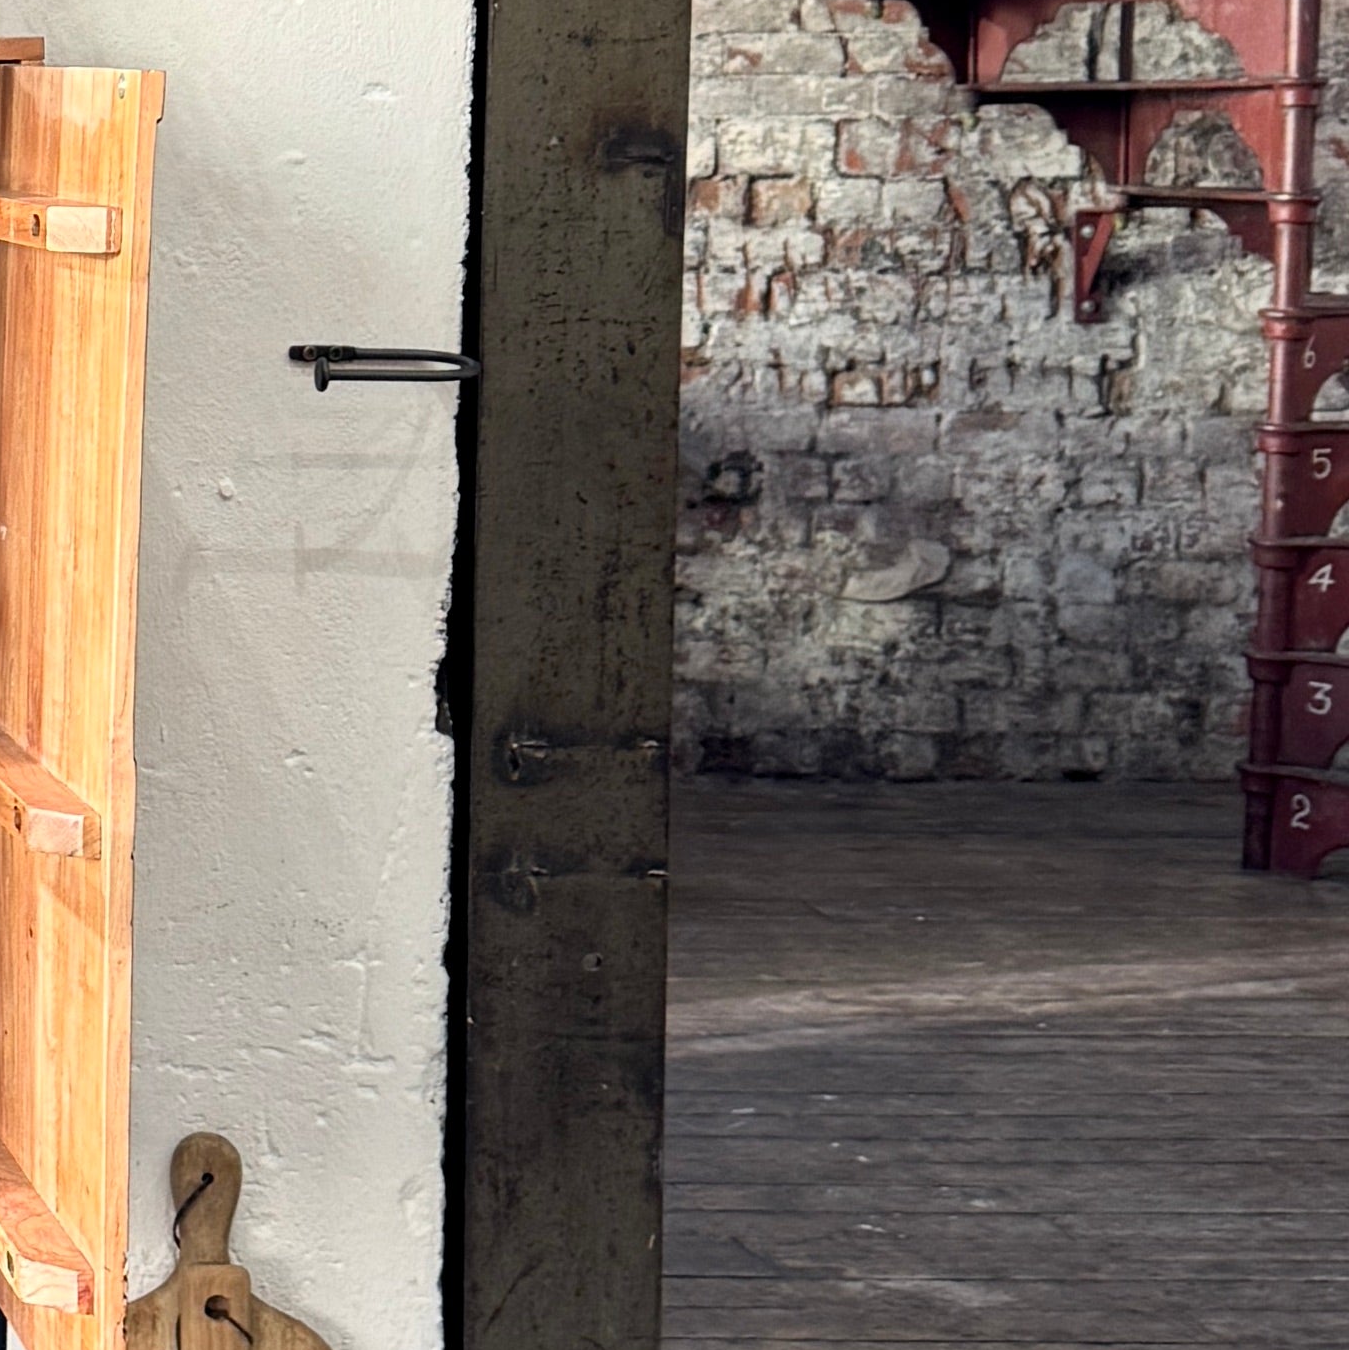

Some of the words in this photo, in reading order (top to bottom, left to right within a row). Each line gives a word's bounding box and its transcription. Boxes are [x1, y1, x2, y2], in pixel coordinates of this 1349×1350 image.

[1303, 333, 1317, 369] 6
[1312, 447, 1333, 481] 5
[1307, 562, 1336, 593] 4
[1307, 680, 1333, 715] 3
[1290, 793, 1311, 830] 2
